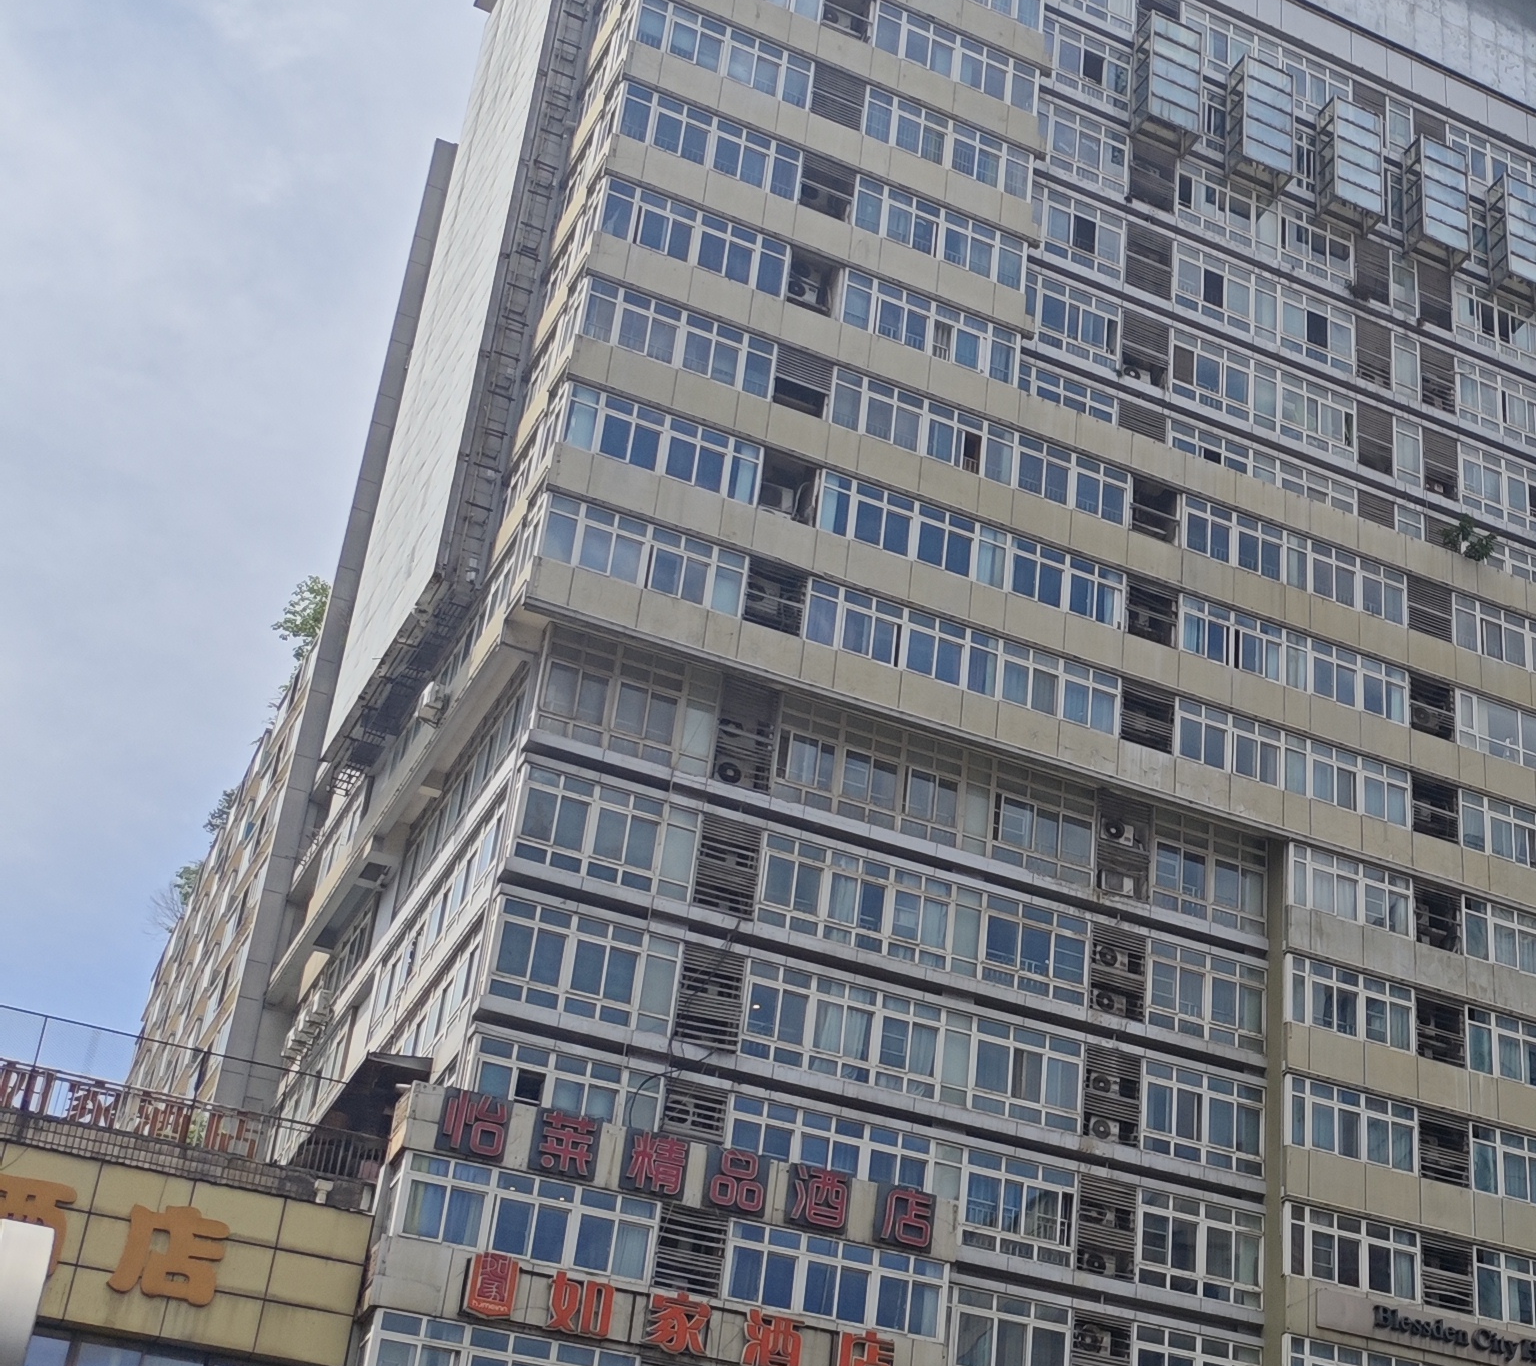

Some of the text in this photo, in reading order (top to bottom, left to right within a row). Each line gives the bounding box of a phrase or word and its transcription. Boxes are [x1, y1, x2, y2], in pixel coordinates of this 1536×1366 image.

[443, 1090, 933, 1248] 怡莱精品酒店
[1373, 1304, 1469, 1348] Blessden
[1471, 1327, 1519, 1363] City
